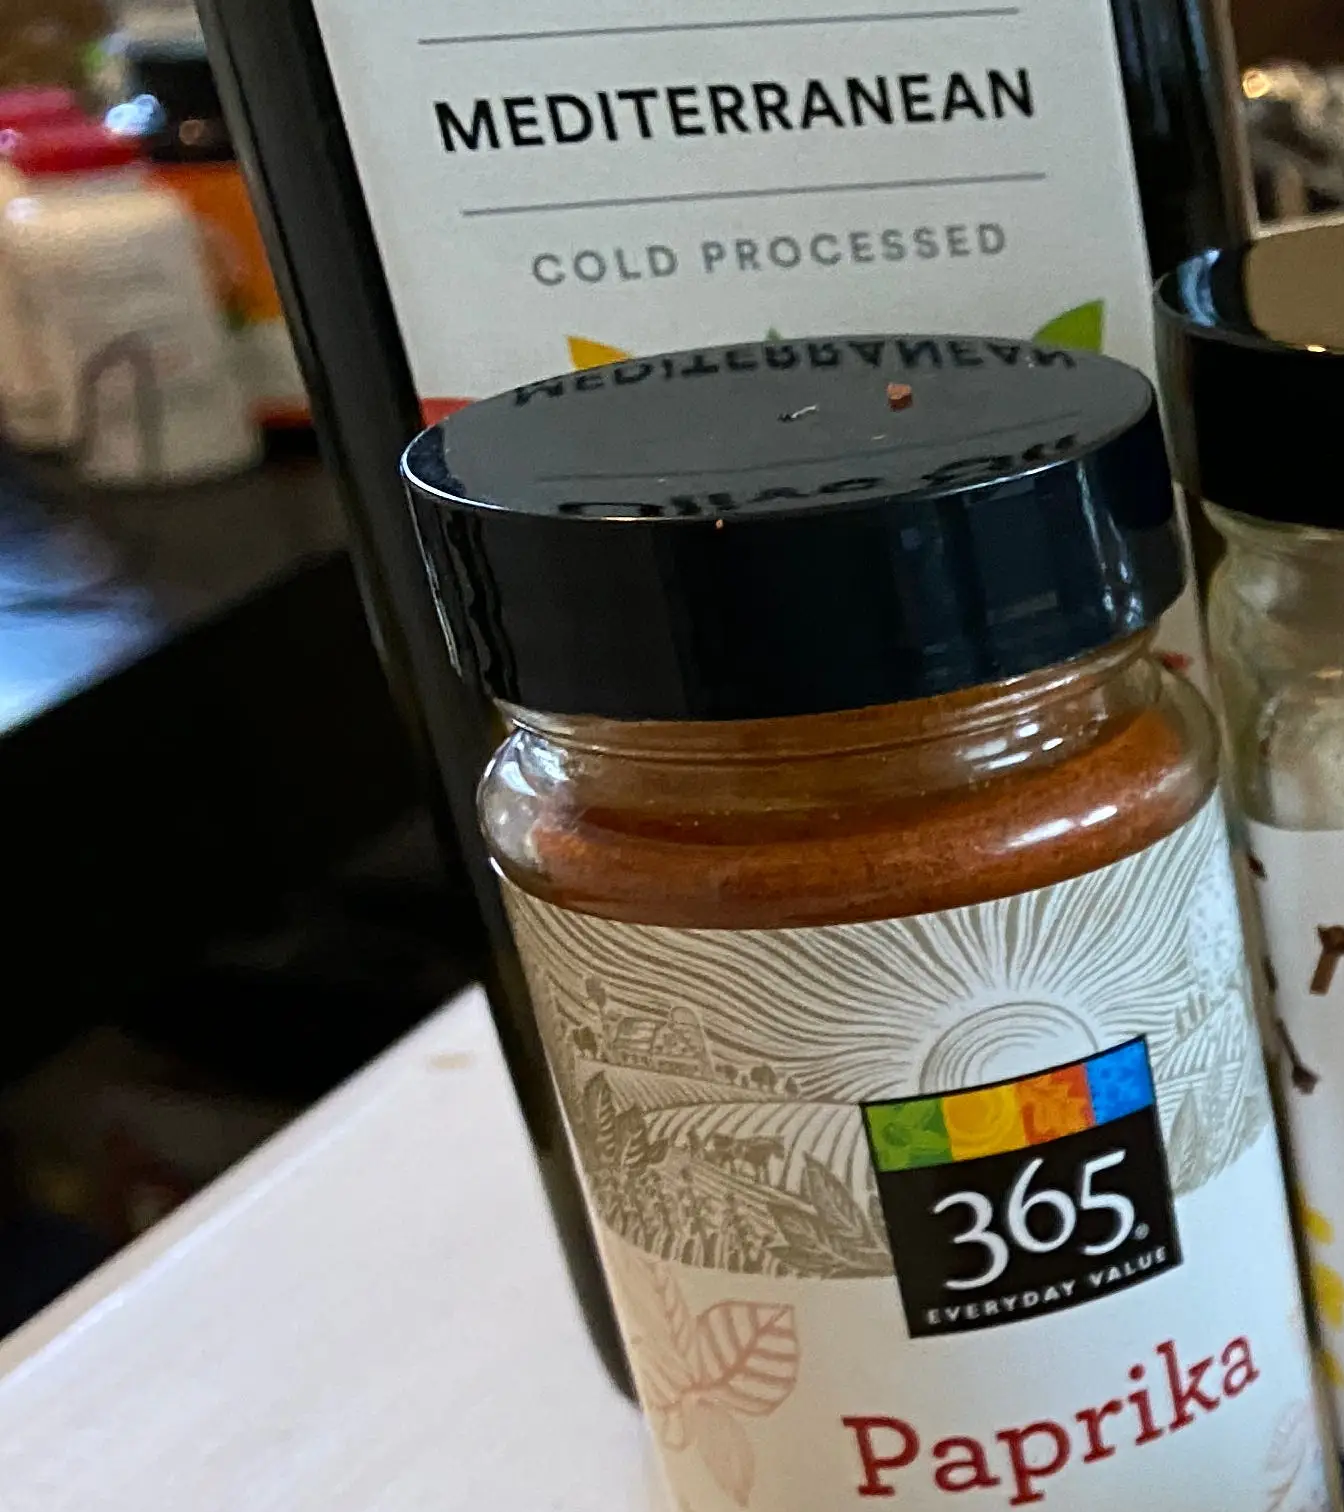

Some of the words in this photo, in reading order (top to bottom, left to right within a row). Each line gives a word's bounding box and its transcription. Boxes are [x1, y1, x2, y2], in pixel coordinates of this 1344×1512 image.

[435, 68, 1036, 153] MEDITERRANEAN
[531, 236, 680, 288] COLD
[702, 222, 1008, 274] PROCESSED
[926, 1278, 1077, 1326] EVERYDAY
[1087, 1245, 1168, 1288] VALUE
[841, 1334, 1261, 1506] Paprika
